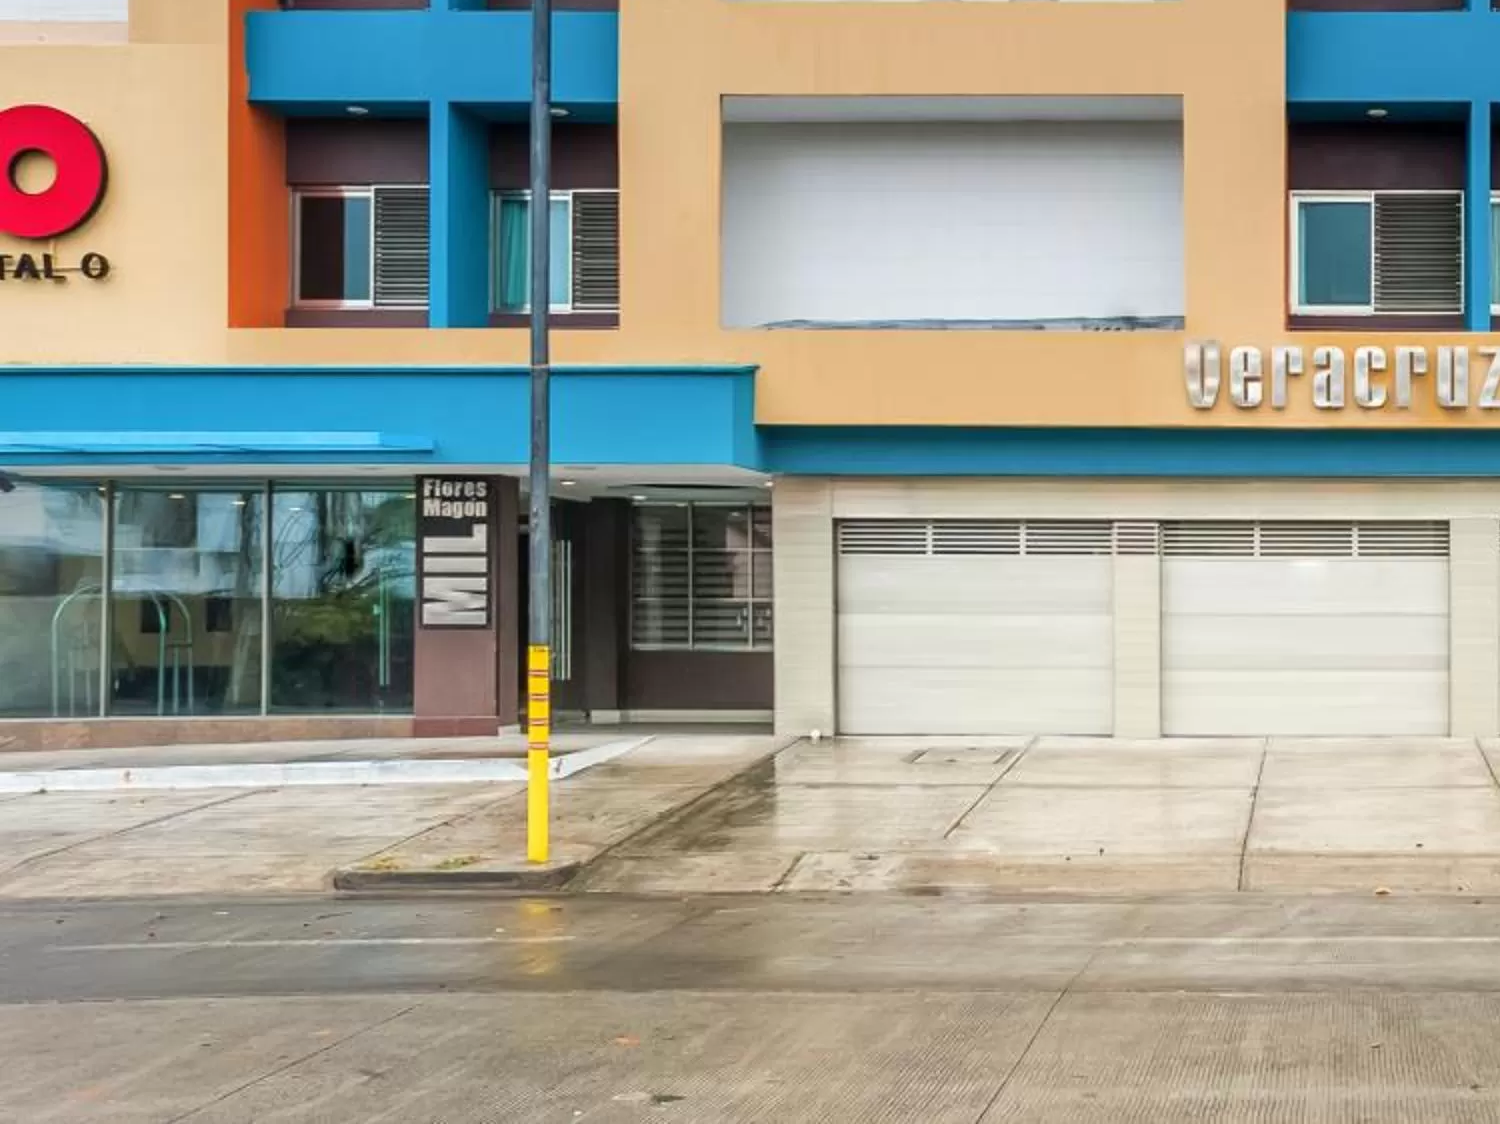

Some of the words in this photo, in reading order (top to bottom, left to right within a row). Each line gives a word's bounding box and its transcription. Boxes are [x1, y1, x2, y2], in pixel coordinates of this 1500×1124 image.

[81, 252, 110, 279] O
[423, 478, 487, 497] Flores
[422, 523, 488, 625] MIL
